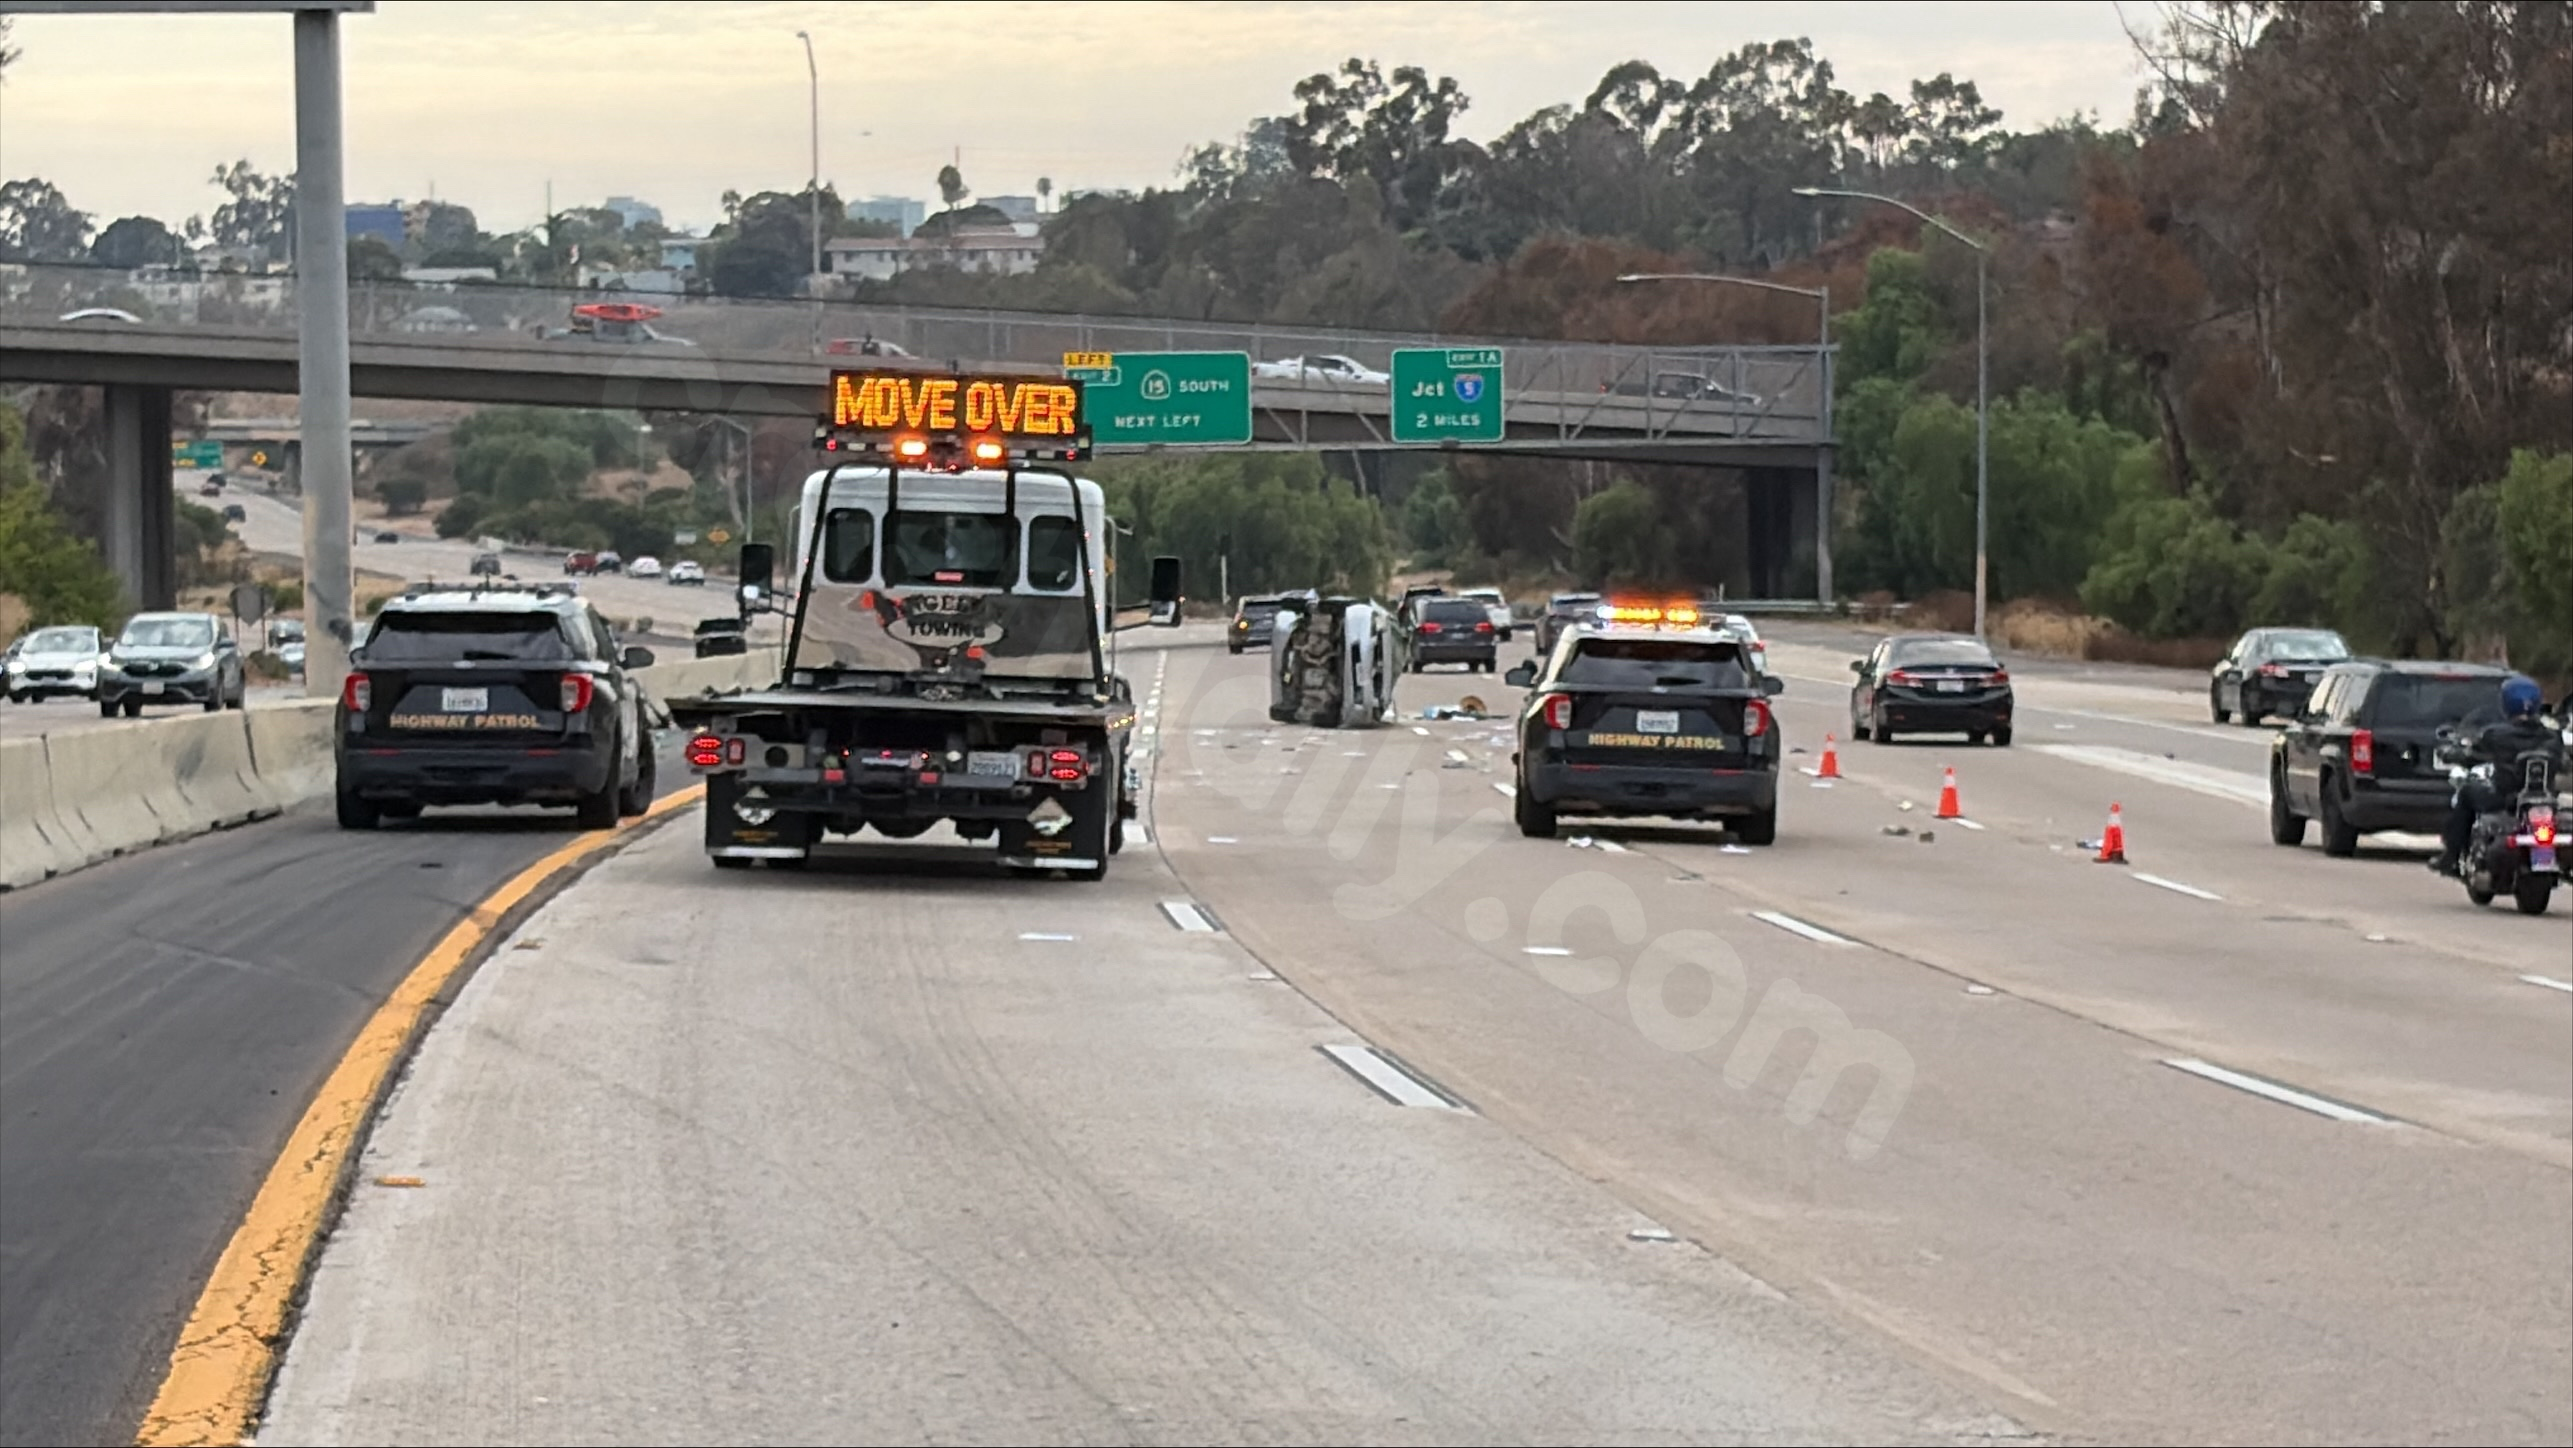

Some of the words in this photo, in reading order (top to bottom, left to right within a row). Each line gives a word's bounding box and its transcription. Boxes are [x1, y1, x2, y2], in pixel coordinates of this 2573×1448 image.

[1067, 354, 1106, 366] LEFT
[1479, 352, 1498, 363] 1A
[1102, 371, 1112, 382] 2
[1149, 381, 1165, 394] 15
[1179, 380, 1230, 393] SOUTH
[1411, 381, 1445, 397] Jct
[1463, 381, 1475, 396] 5
[835, 376, 958, 429] MOVE
[965, 381, 1077, 434] OVER
[1115, 416, 1155, 428] NEXT
[1163, 415, 1201, 428] LEFT
[1416, 413, 1428, 428] 2
[1434, 414, 1481, 426] MILES
[906, 620, 986, 639] TOWING
[390, 714, 469, 728] HIGHWAY
[474, 714, 541, 728] PATROL
[1588, 733, 1661, 747] HIGHWAY
[1664, 735, 1725, 750] PATROL
